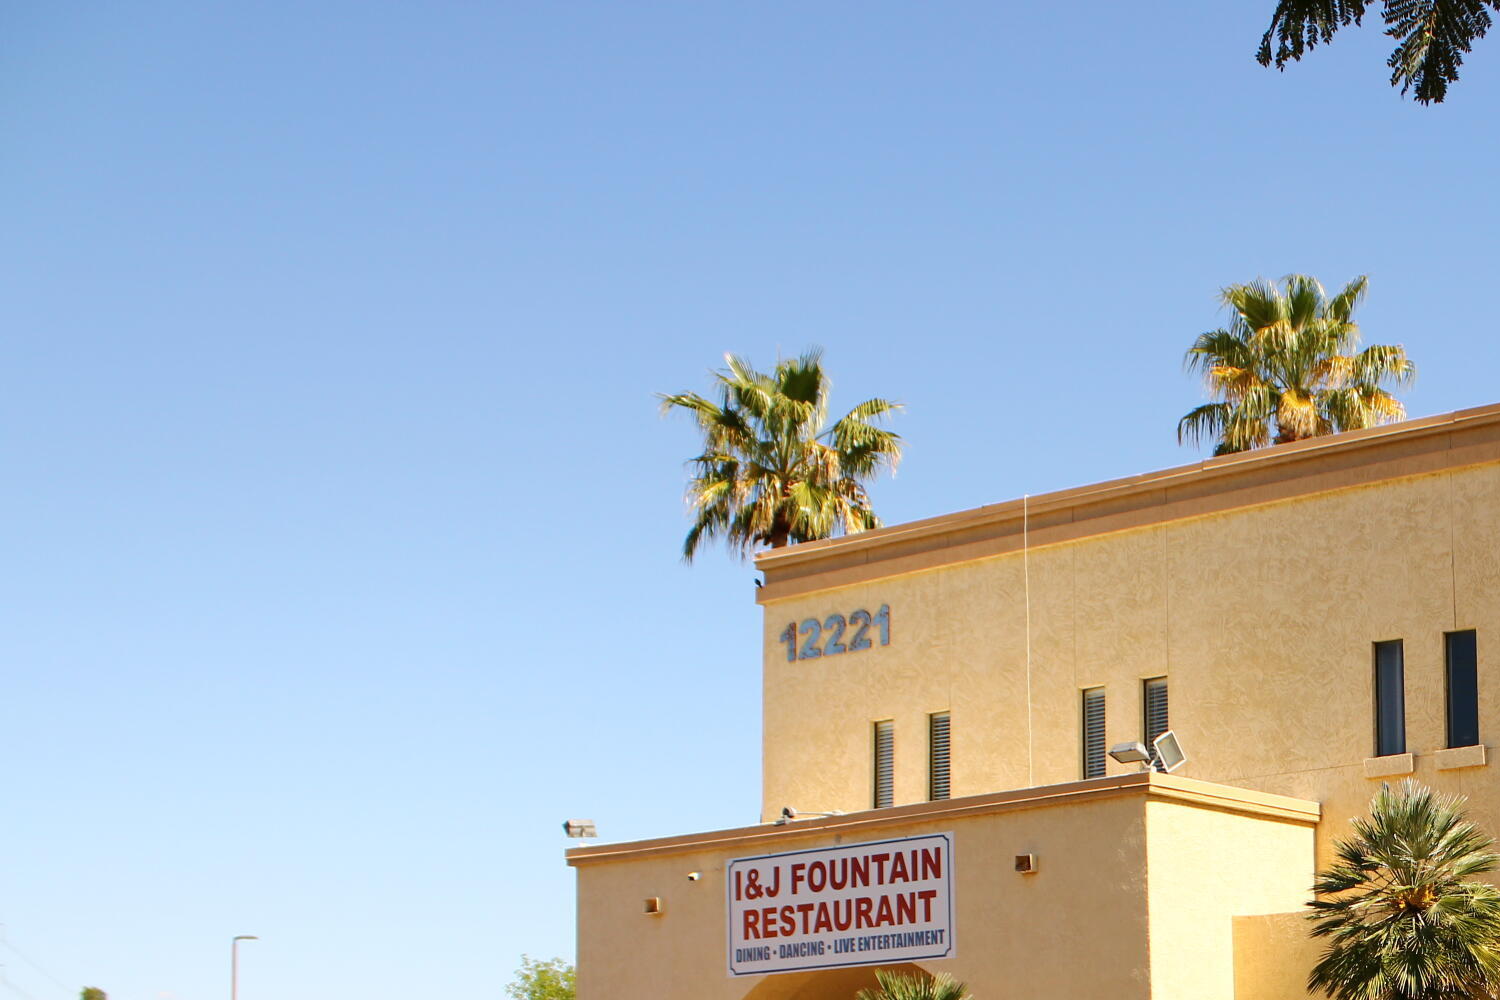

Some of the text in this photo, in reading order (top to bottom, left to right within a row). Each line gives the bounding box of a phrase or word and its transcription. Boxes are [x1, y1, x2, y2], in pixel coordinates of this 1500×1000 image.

[780, 604, 890, 662] 12221
[735, 846, 942, 901] I&J FOUNTAIN
[743, 889, 937, 941] RESTAURANT
[736, 928, 945, 963] DINING DANCING LIVE ENTERTAINMENT
